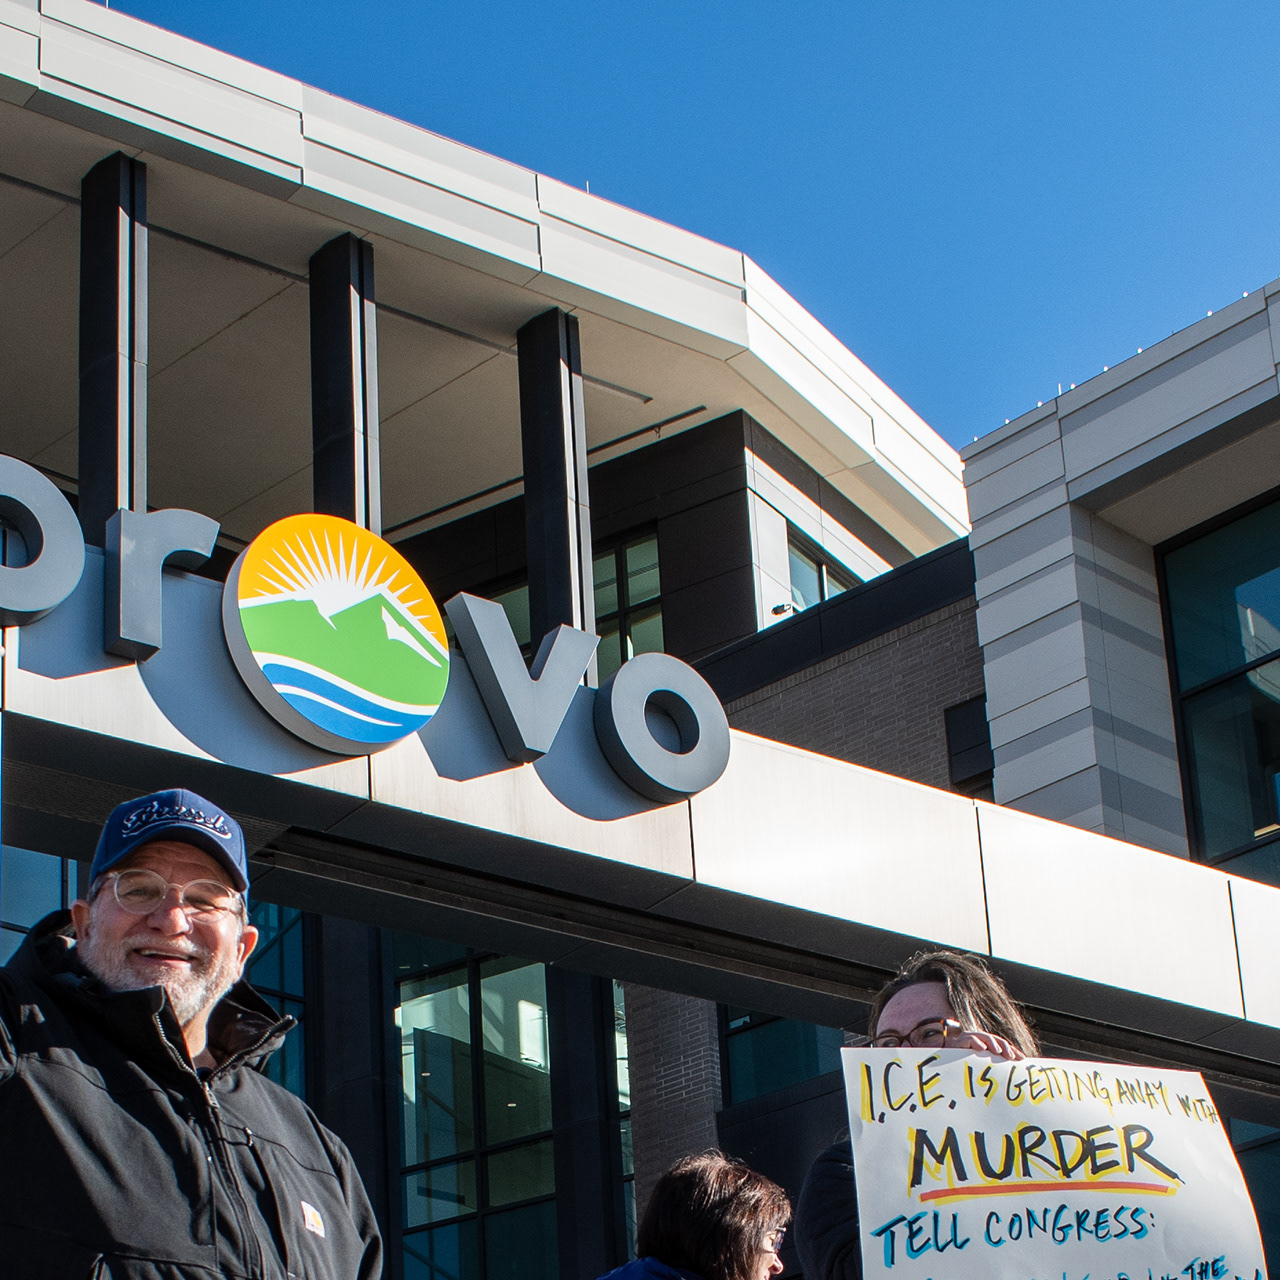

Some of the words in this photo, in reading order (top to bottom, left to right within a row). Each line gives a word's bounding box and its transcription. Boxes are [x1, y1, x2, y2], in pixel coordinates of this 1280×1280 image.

[965, 1062, 995, 1105] IS
[1005, 1064, 1111, 1106] GETTING
[1115, 1075, 1172, 1117] AWAY
[1175, 1092, 1219, 1125] WITH
[908, 1122, 1185, 1192] MURDER
[873, 1210, 970, 1268] TELL
[985, 1204, 1157, 1245] CONGRESS:
